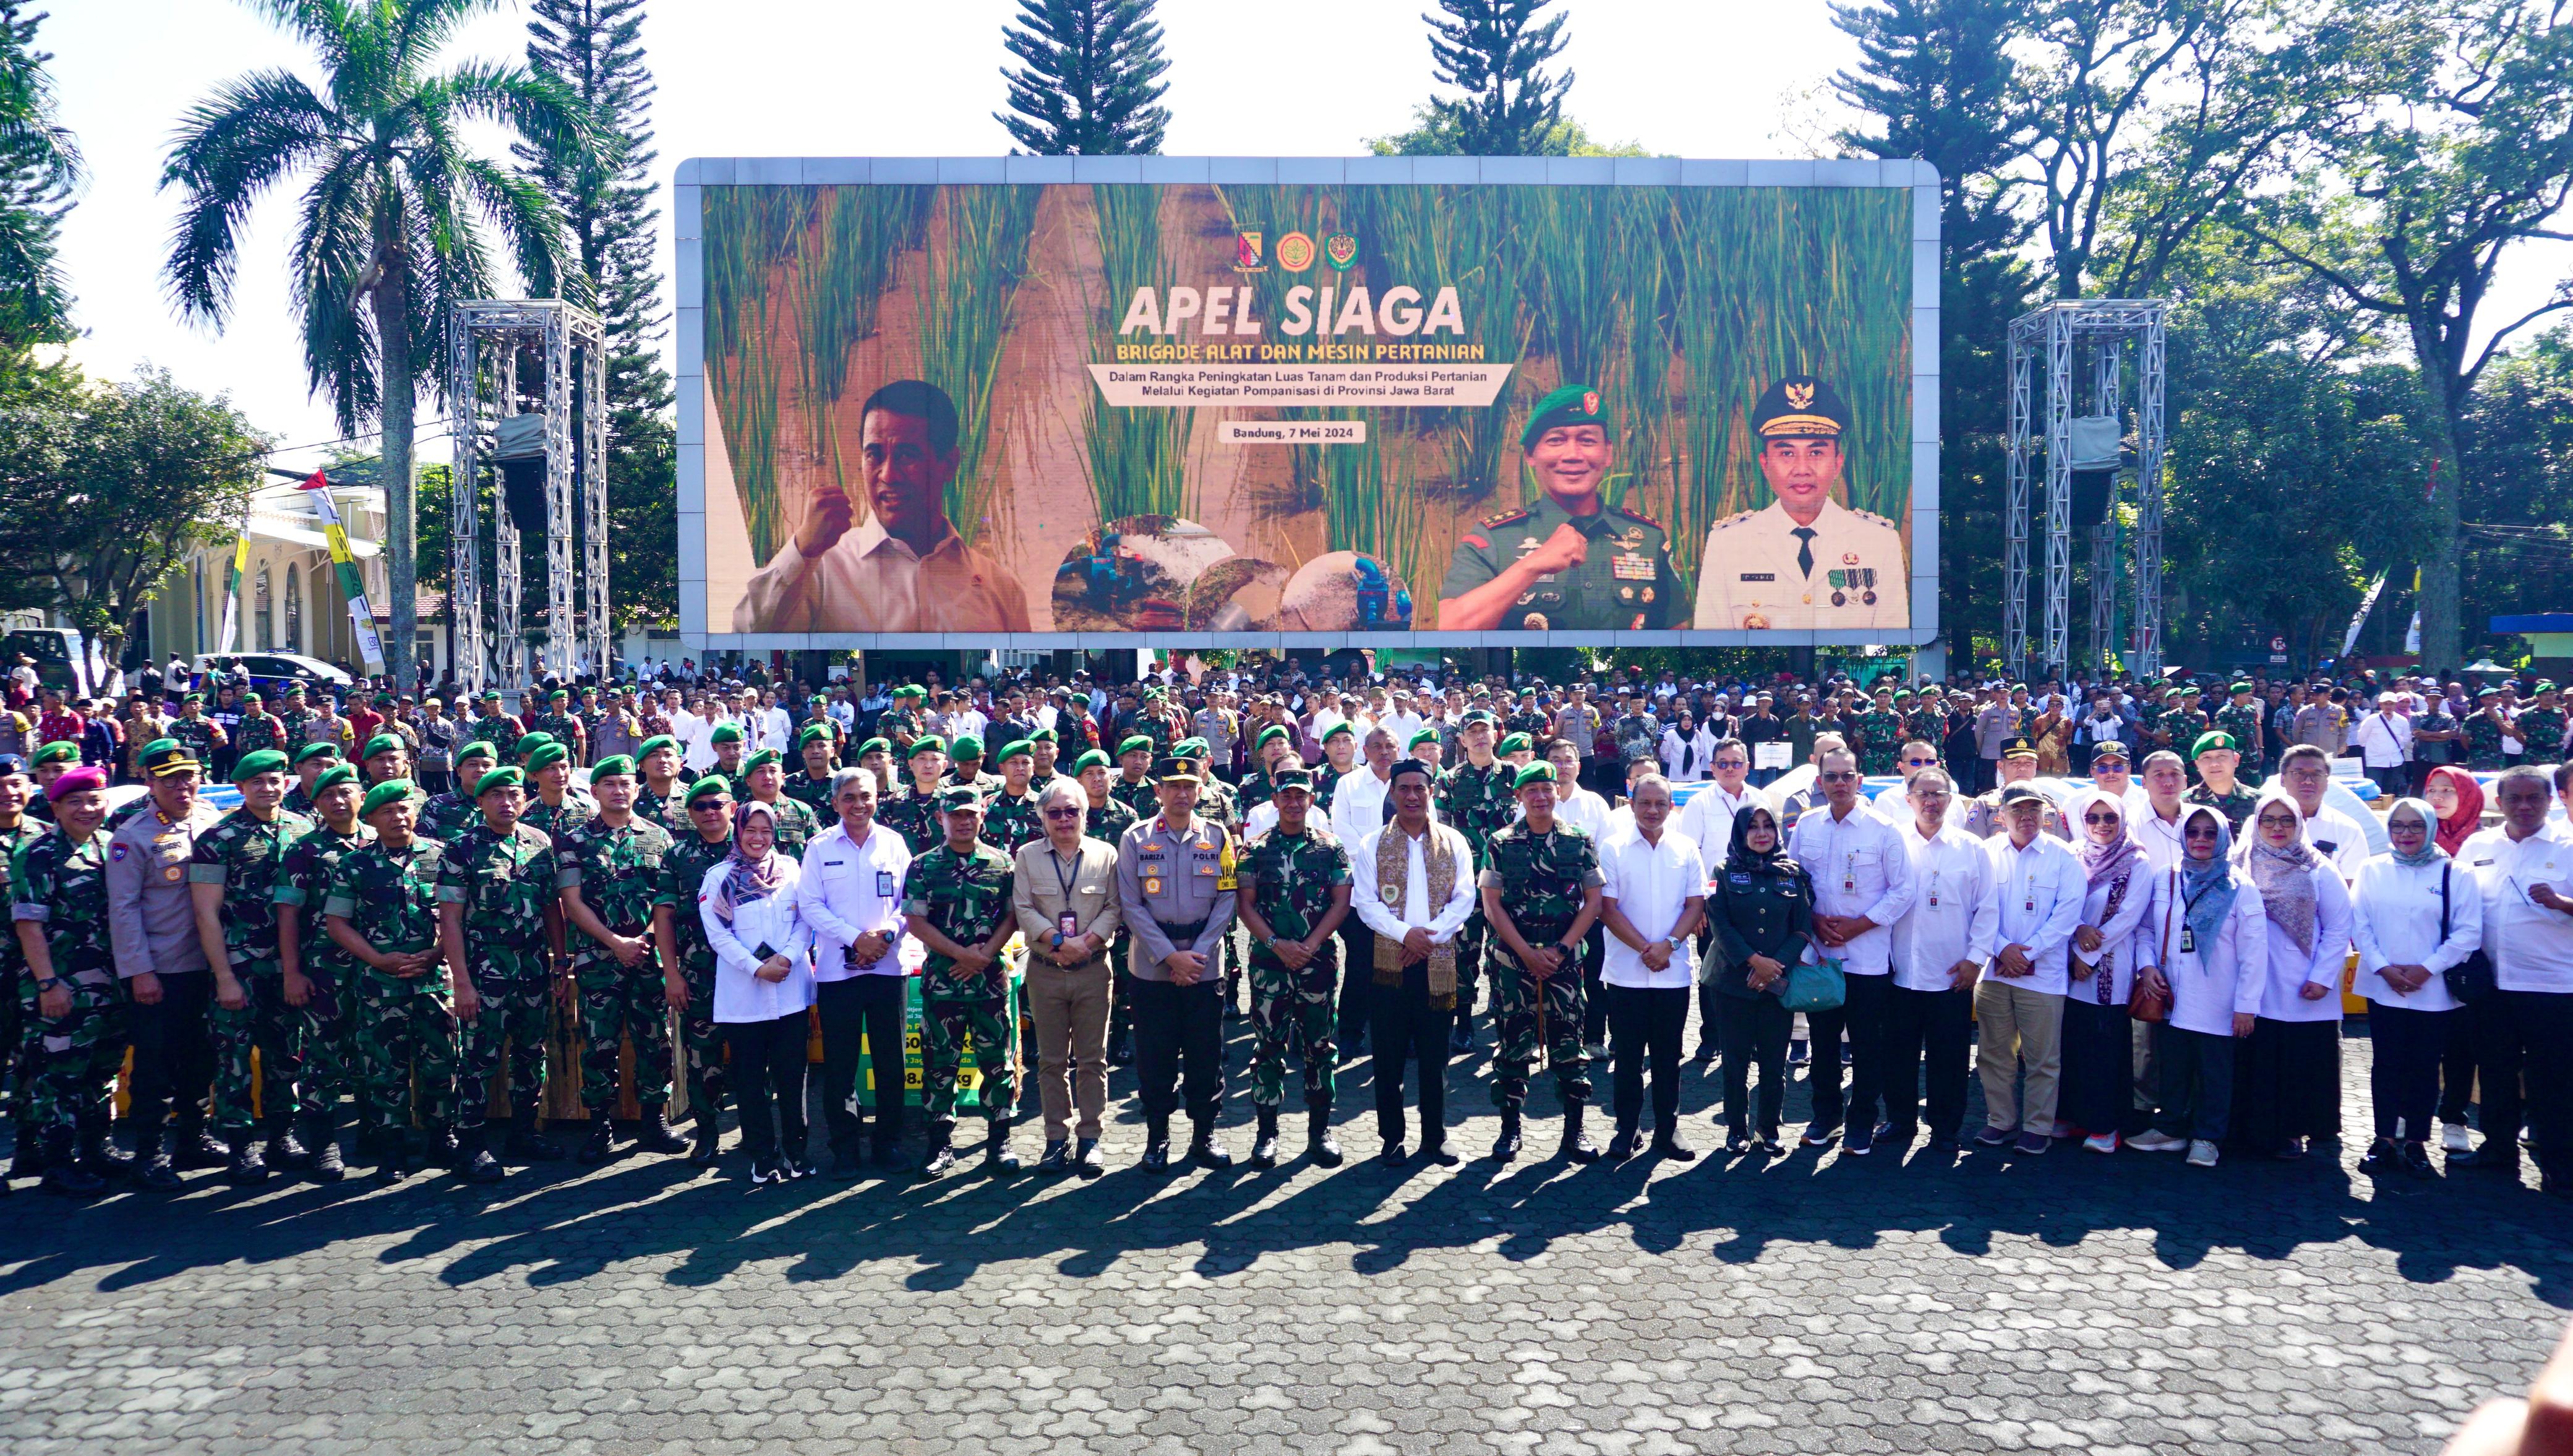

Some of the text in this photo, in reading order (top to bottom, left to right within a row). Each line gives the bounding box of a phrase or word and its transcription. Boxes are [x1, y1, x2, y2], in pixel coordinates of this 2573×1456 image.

[1119, 285, 1465, 336] APEL SIAGA
[1117, 345, 1484, 360] BRIGADE ALAT DAN MESIN PERTANIAN
[1110, 372, 1487, 384] Dalam Rangka Peningkatan Luas Tanam dan Produksi Pertanian
[1142, 385, 1454, 398] Melalui Kegiatan Pompanisasi di Provinsi Jawa Barat
[1233, 428, 1353, 439] Bandung, 7 Mei 2024
